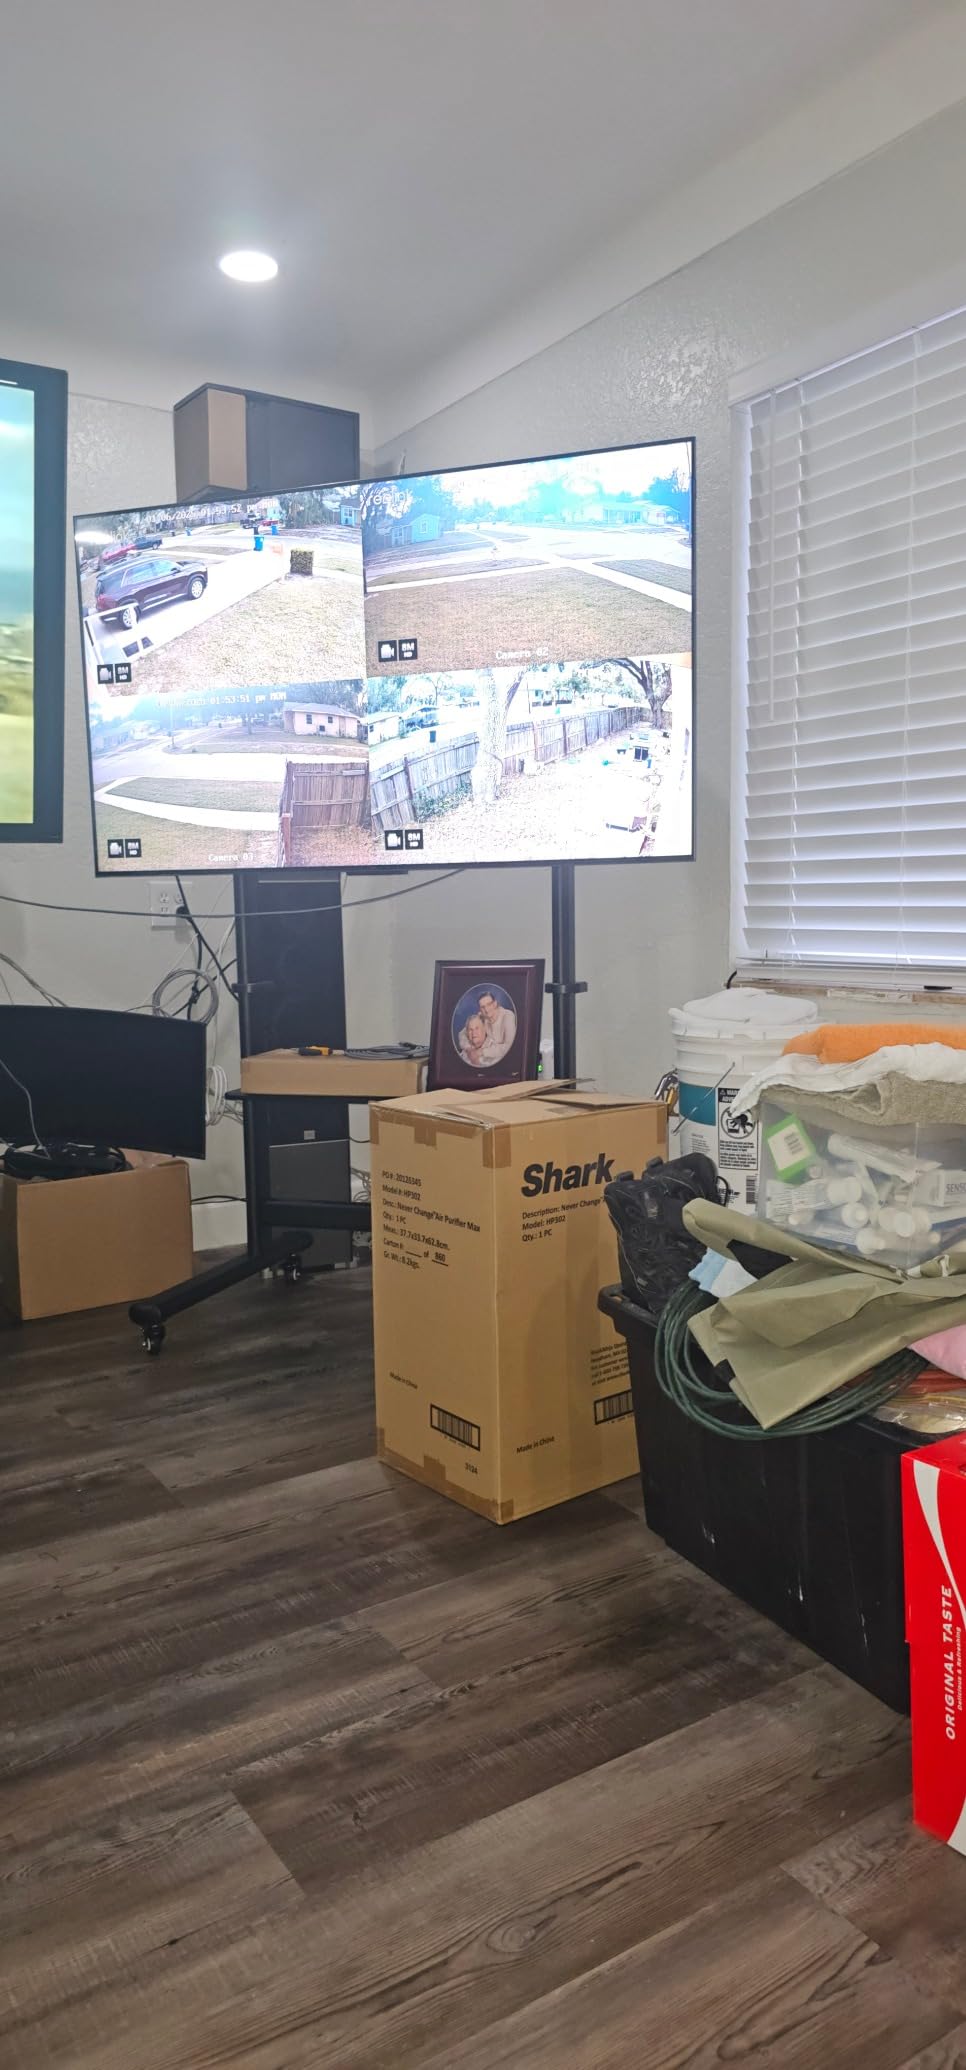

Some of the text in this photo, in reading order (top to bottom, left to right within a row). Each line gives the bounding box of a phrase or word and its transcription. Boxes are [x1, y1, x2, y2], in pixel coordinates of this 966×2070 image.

[521, 1153, 615, 1197] Shark
[522, 1206, 560, 1219] Description:
[561, 1202, 579, 1211] Never
[467, 1221, 481, 1232] Max
[522, 1215, 566, 1231] Model: HP302
[544, 1229, 552, 1237] PC
[941, 1585, 956, 1740] ORIGINAL TASTE
